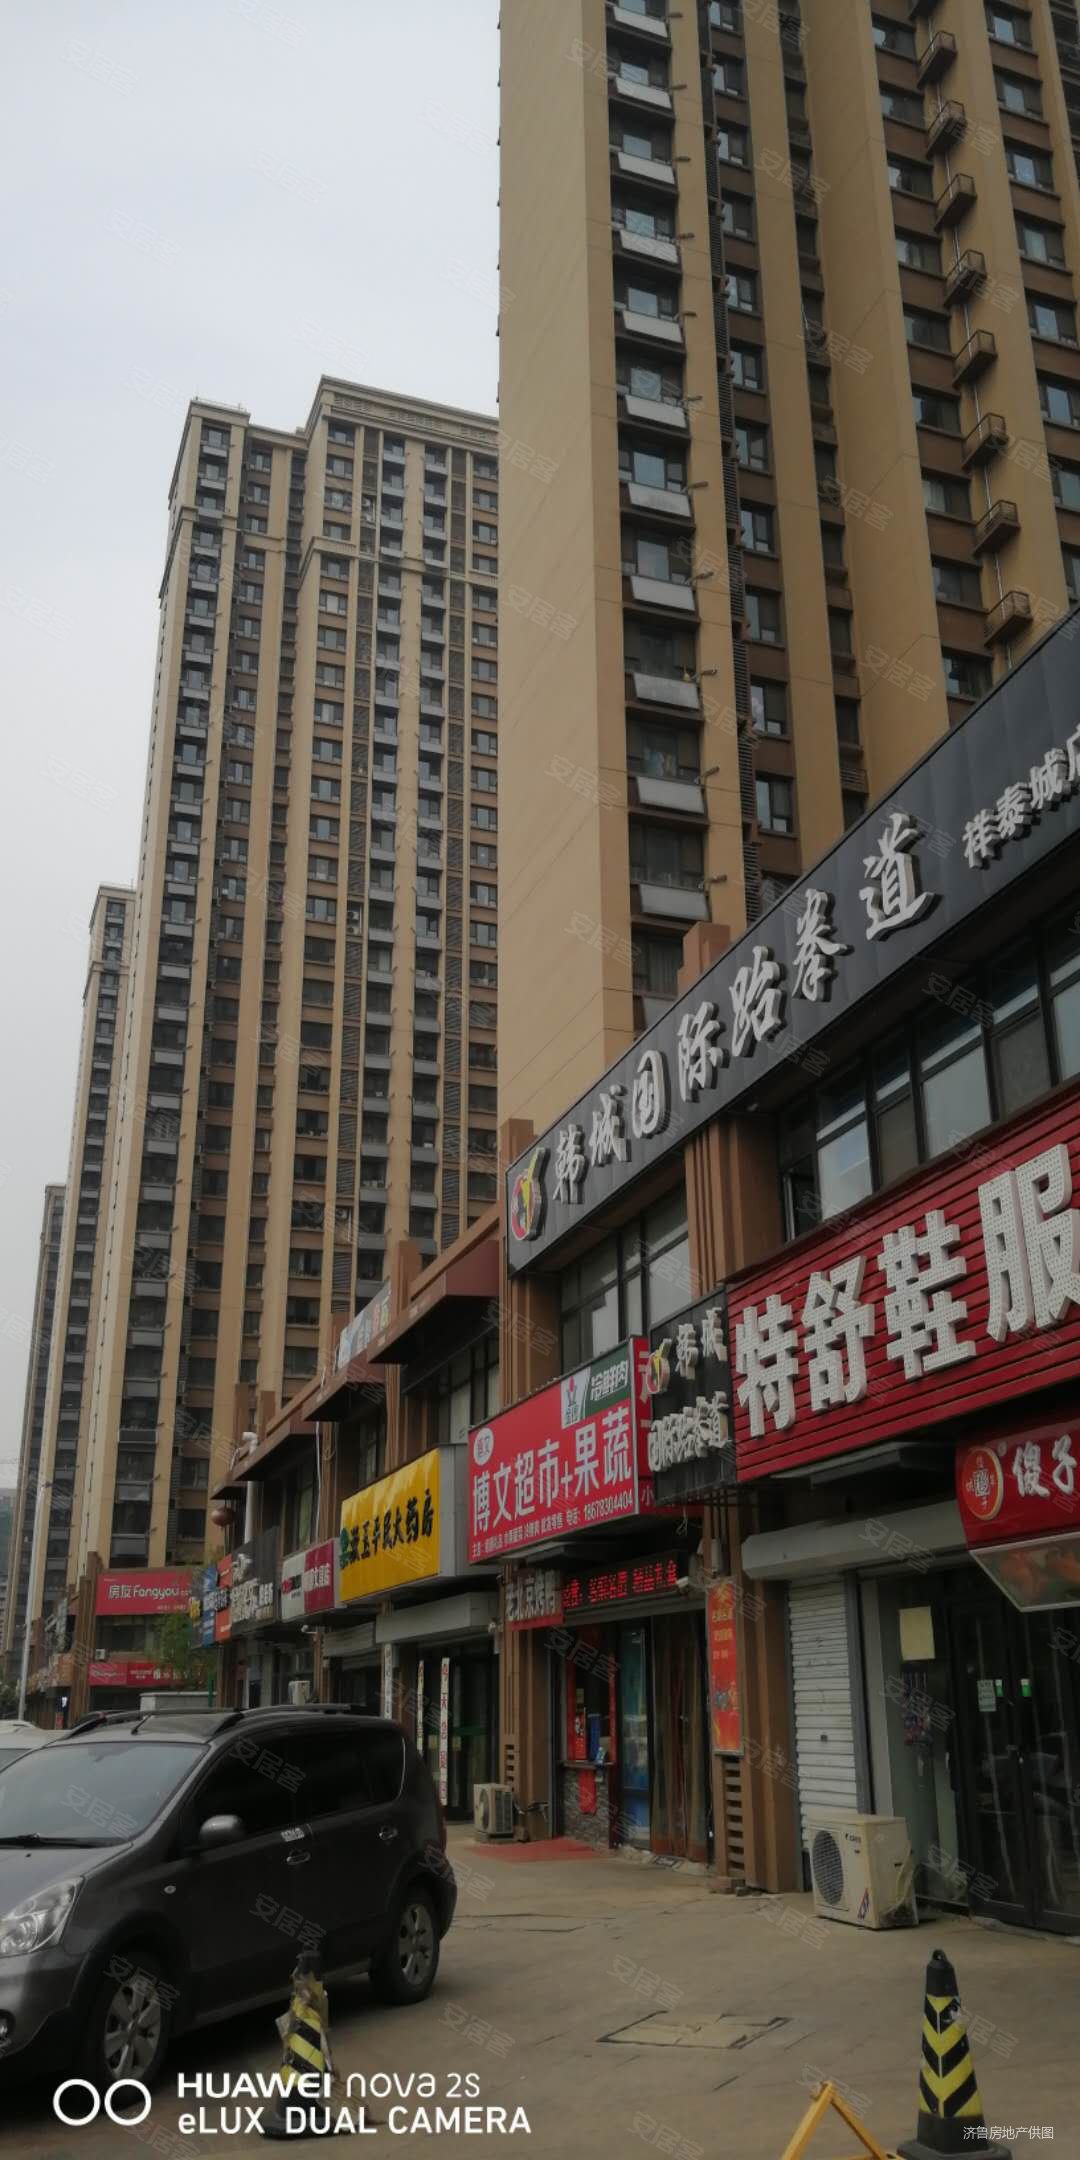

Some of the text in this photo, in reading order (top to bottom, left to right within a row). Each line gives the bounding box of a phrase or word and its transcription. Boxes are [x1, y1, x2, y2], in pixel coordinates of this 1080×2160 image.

[553, 812, 938, 1206] 韩城国际跆拳道
[735, 1143, 1080, 1438] 特舒鞋服
[473, 1406, 632, 1536] 博文超市+果蔬
